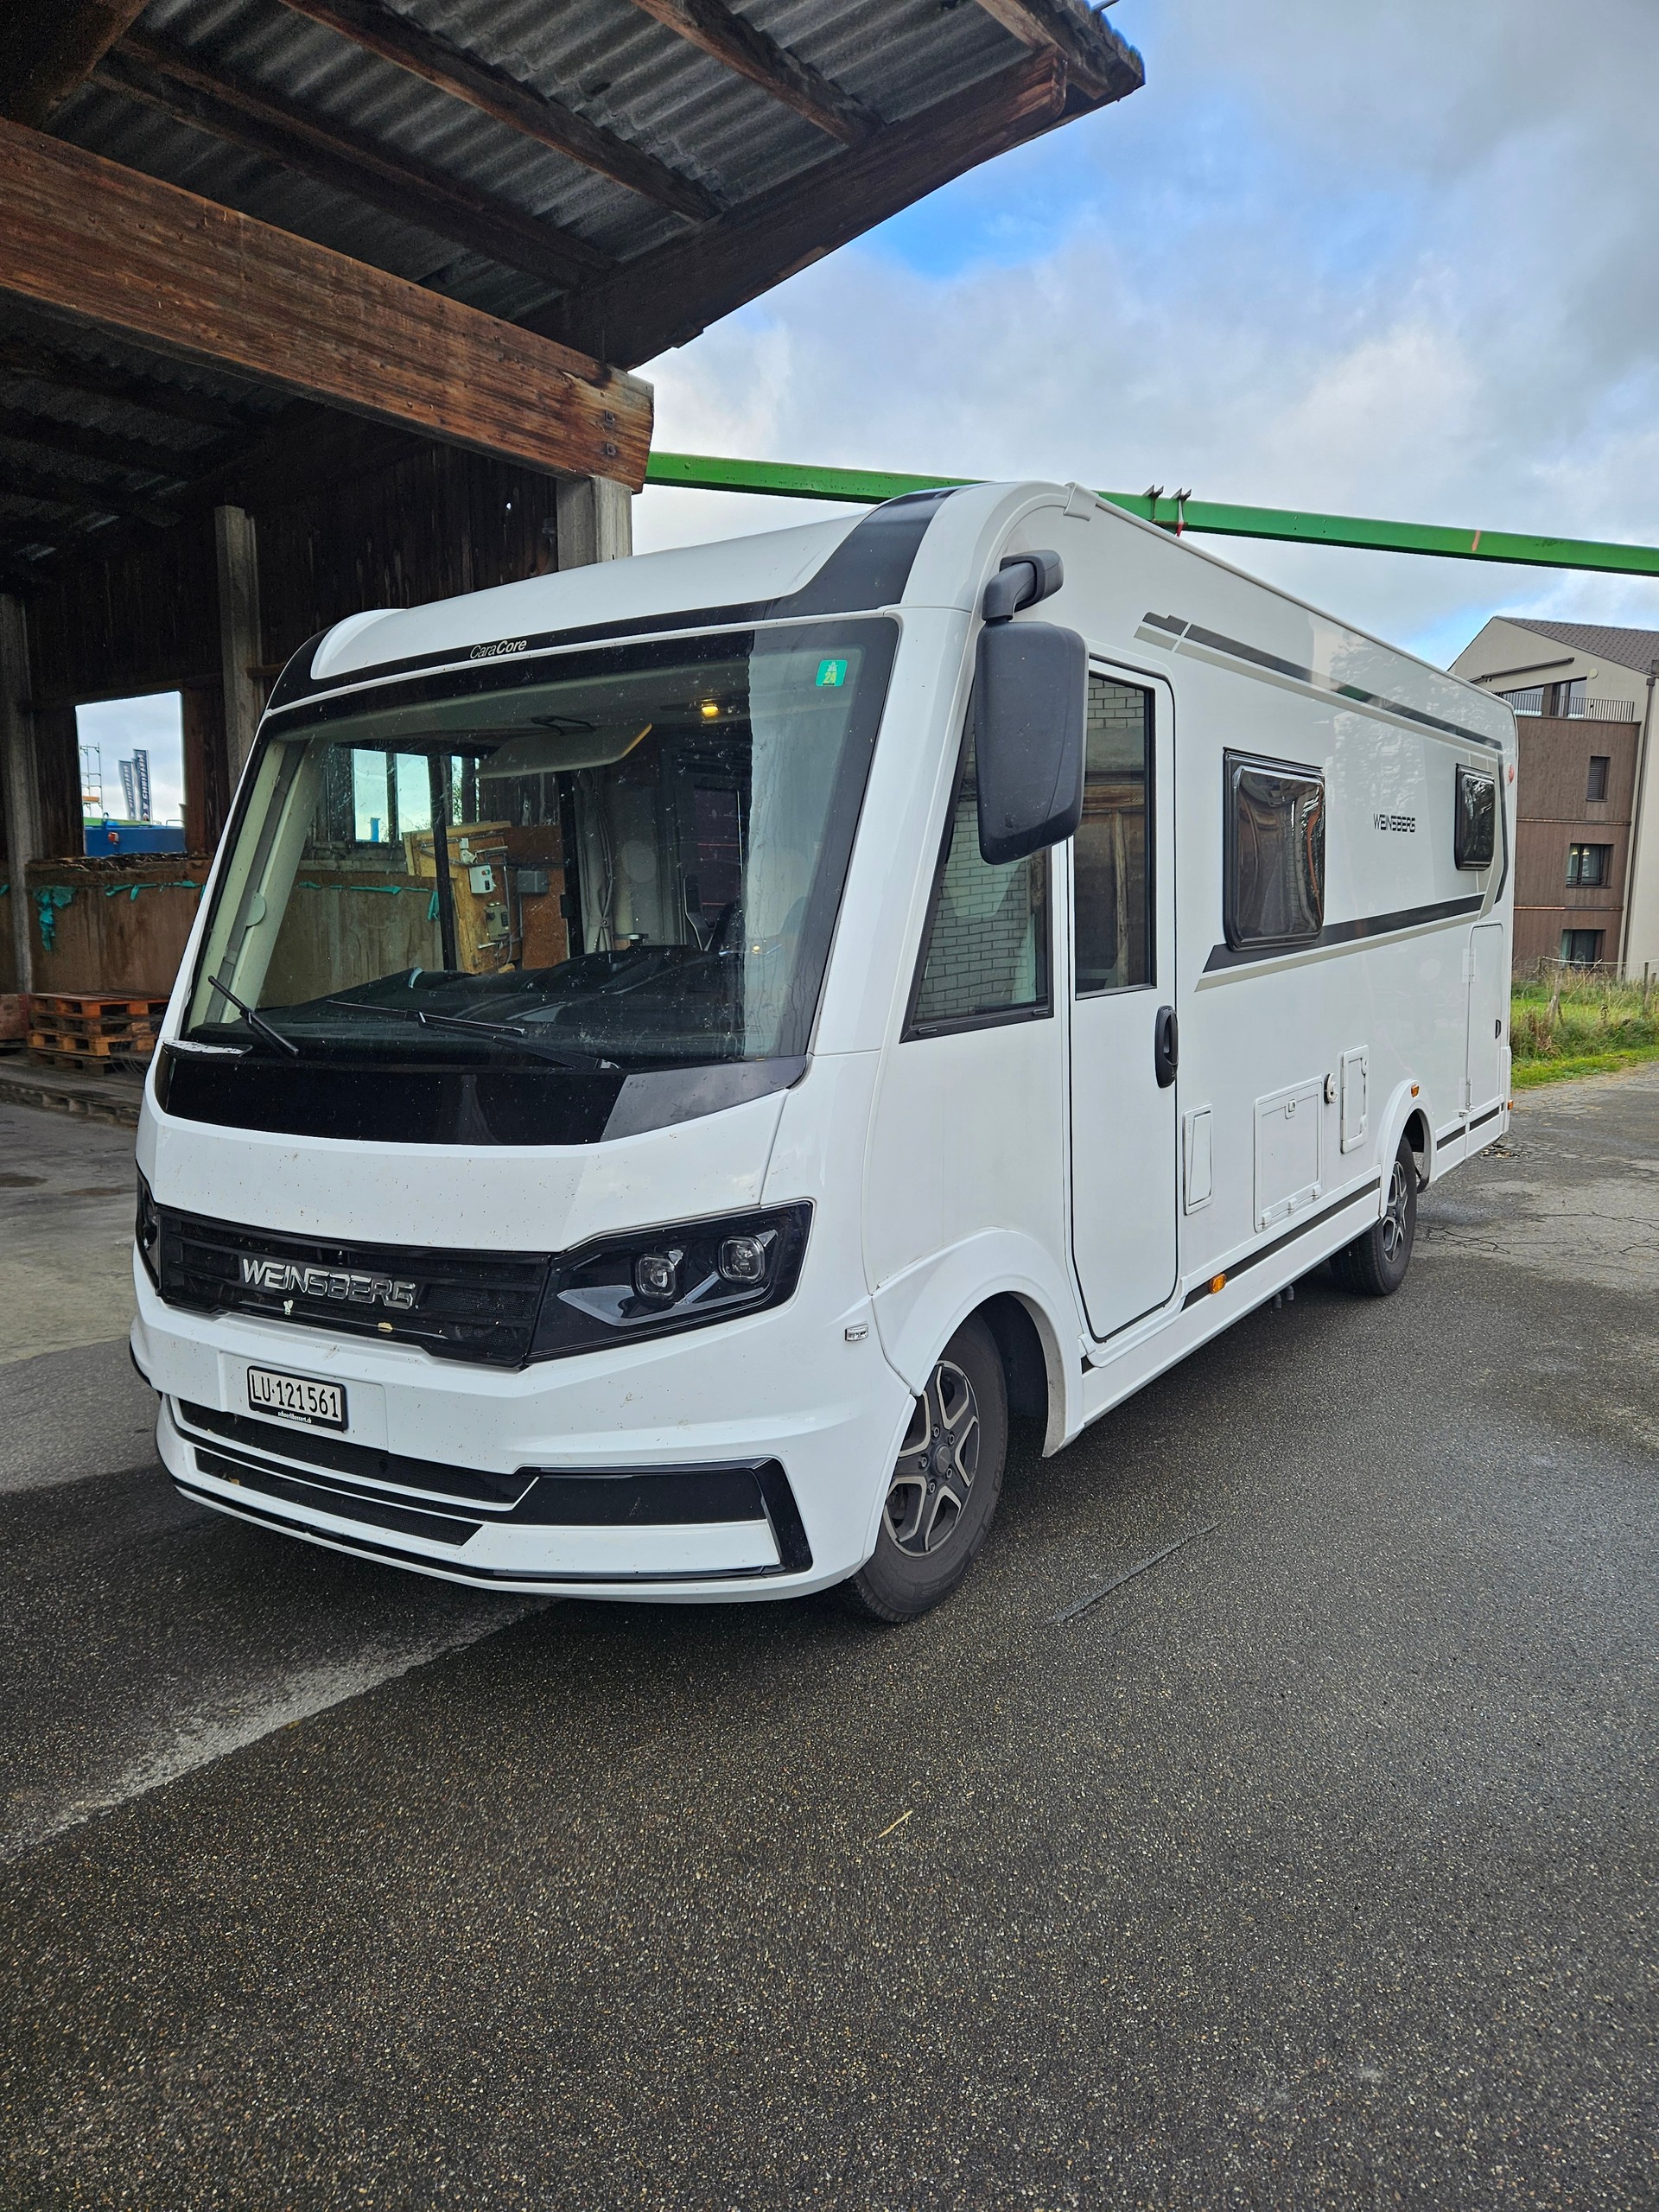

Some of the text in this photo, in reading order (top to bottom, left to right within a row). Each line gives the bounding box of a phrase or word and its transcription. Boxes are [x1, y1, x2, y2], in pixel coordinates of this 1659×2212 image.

[469, 639, 527, 659] CaraCore
[1373, 813, 1416, 833] WEINSBERG
[243, 1258, 416, 1309] WEINSBERG
